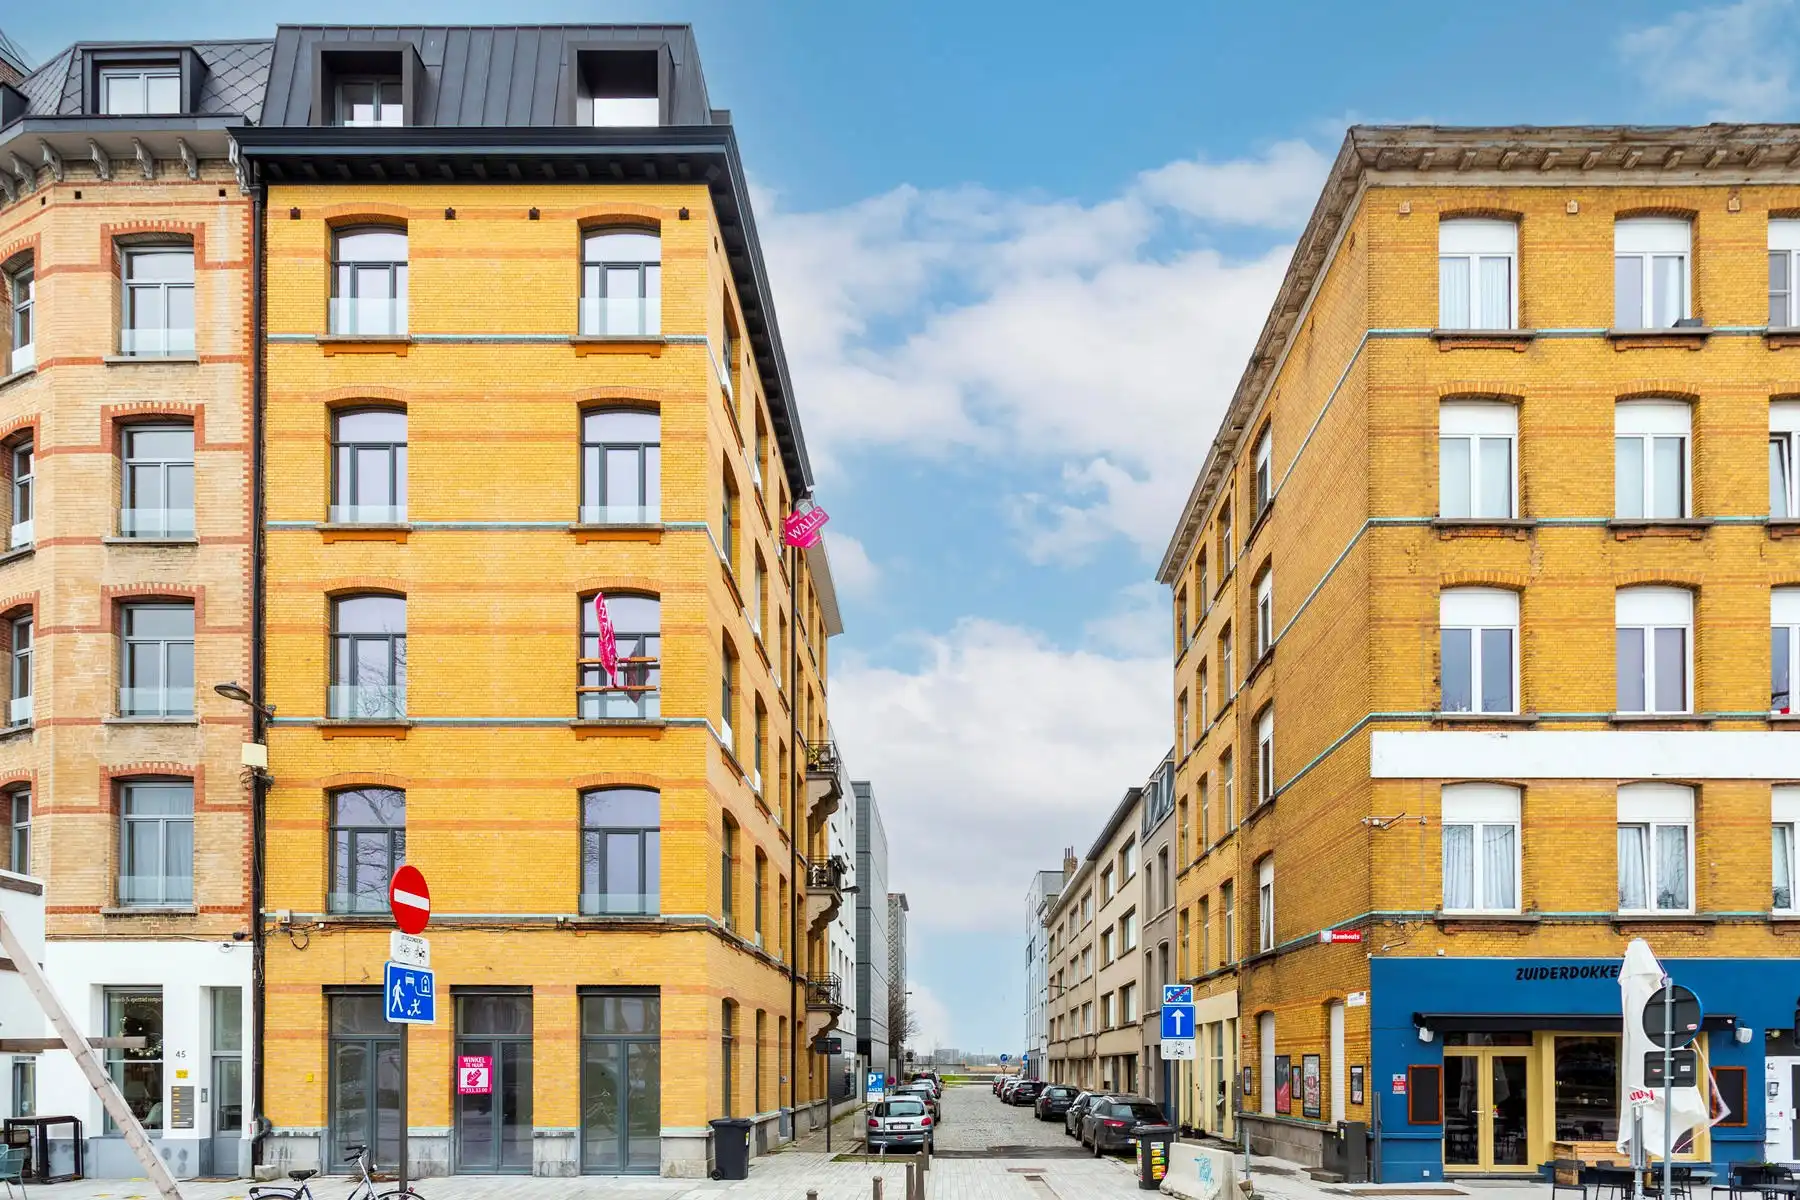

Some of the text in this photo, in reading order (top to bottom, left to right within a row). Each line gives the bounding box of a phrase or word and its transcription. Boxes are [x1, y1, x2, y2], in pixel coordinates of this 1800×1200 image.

[788, 510, 824, 539] WALLS
[1516, 965, 1621, 981] ZUIDERDOKKE
[175, 1050, 186, 1058] 45
